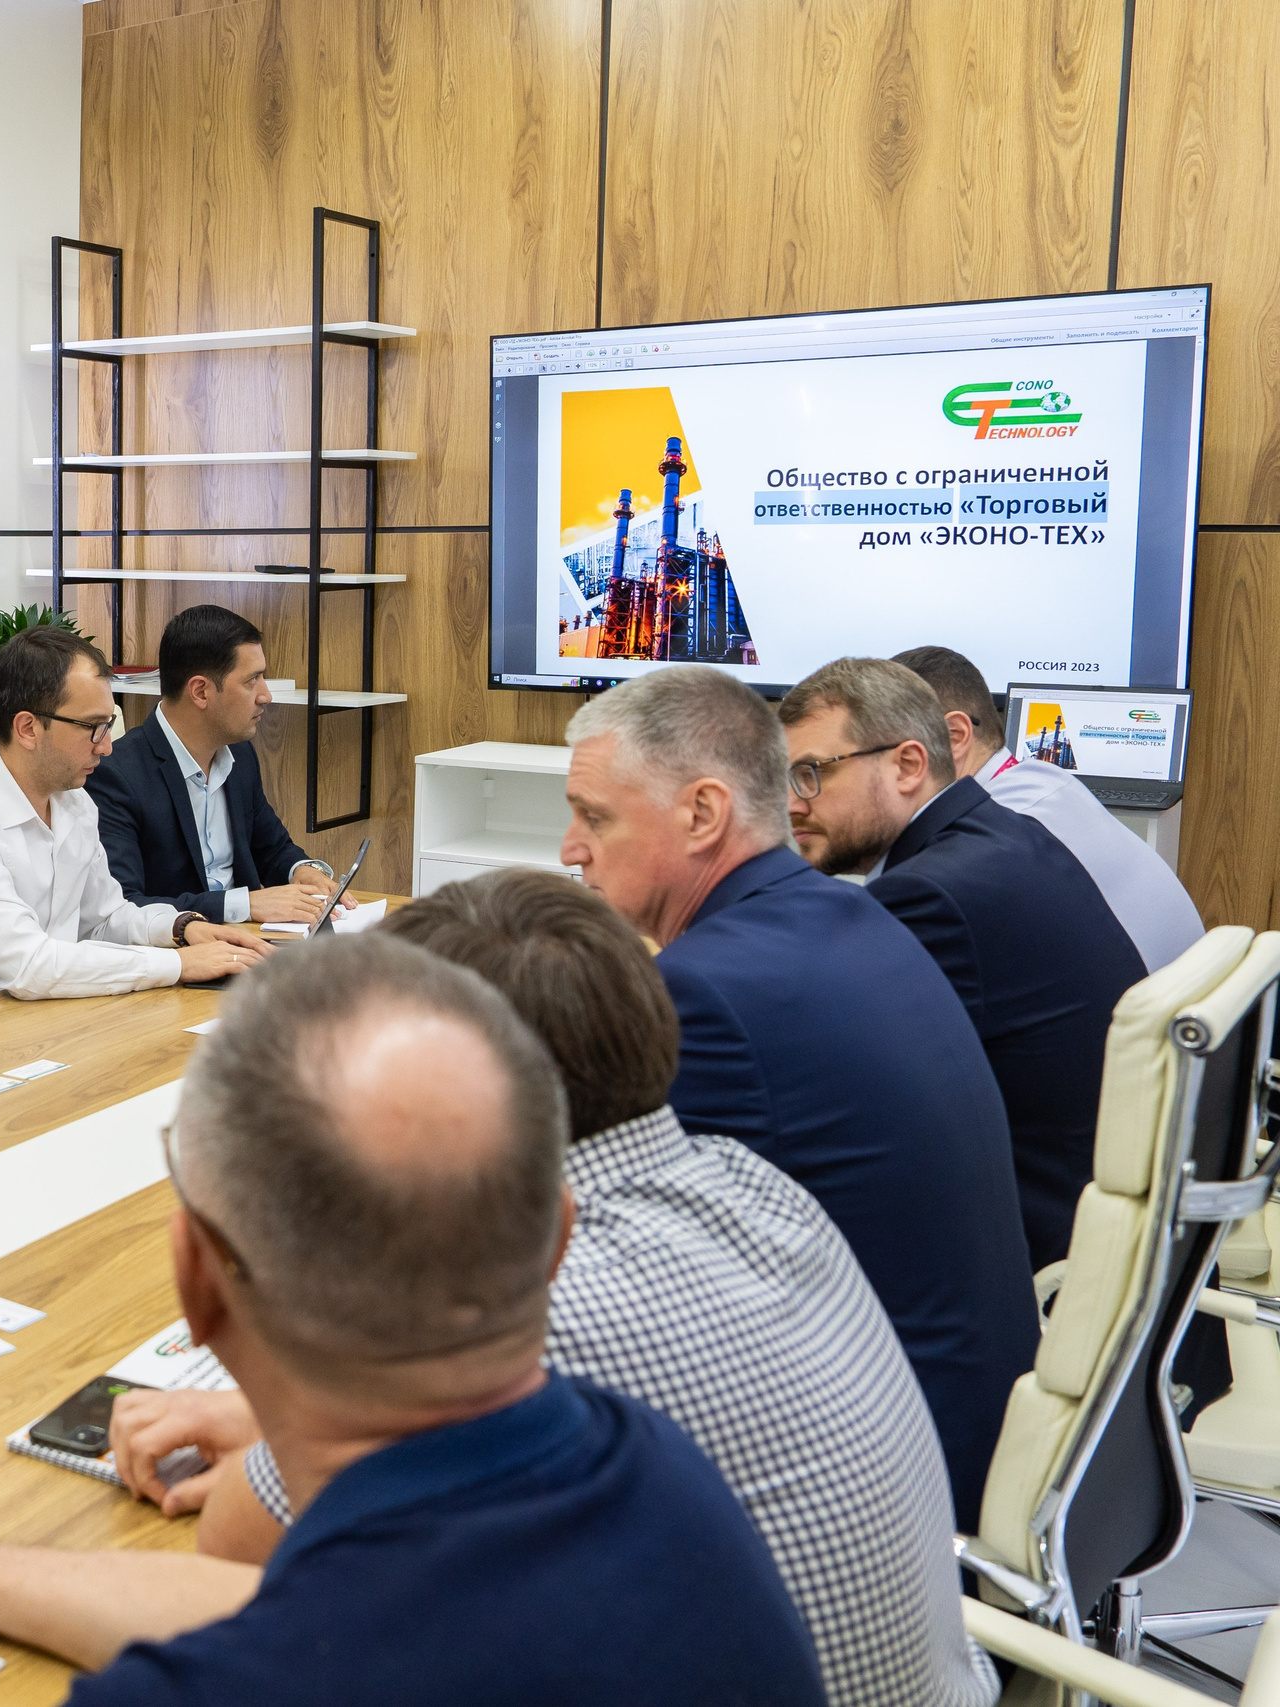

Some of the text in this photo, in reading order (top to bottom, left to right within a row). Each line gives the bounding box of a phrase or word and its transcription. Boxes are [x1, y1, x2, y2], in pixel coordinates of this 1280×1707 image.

[1134, 312, 1163, 320] Настройка
[1066, 331, 1099, 339] Заполнить
[1106, 329, 1139, 338] подписать
[1151, 325, 1199, 335] Комментарии
[990, 334, 1055, 344] Общие инструменты
[766, 459, 1109, 490] Общество с ограниченной
[754, 491, 1107, 519] ответственностью «Торговый
[859, 525, 1105, 549] дом «ЭКОНО-ТЕХ»
[1018, 660, 1100, 672] РОССИЯ 2023
[1083, 724, 1115, 732] Общество
[1121, 726, 1167, 734] ограниченной
[1131, 733, 1166, 741] «Торговый
